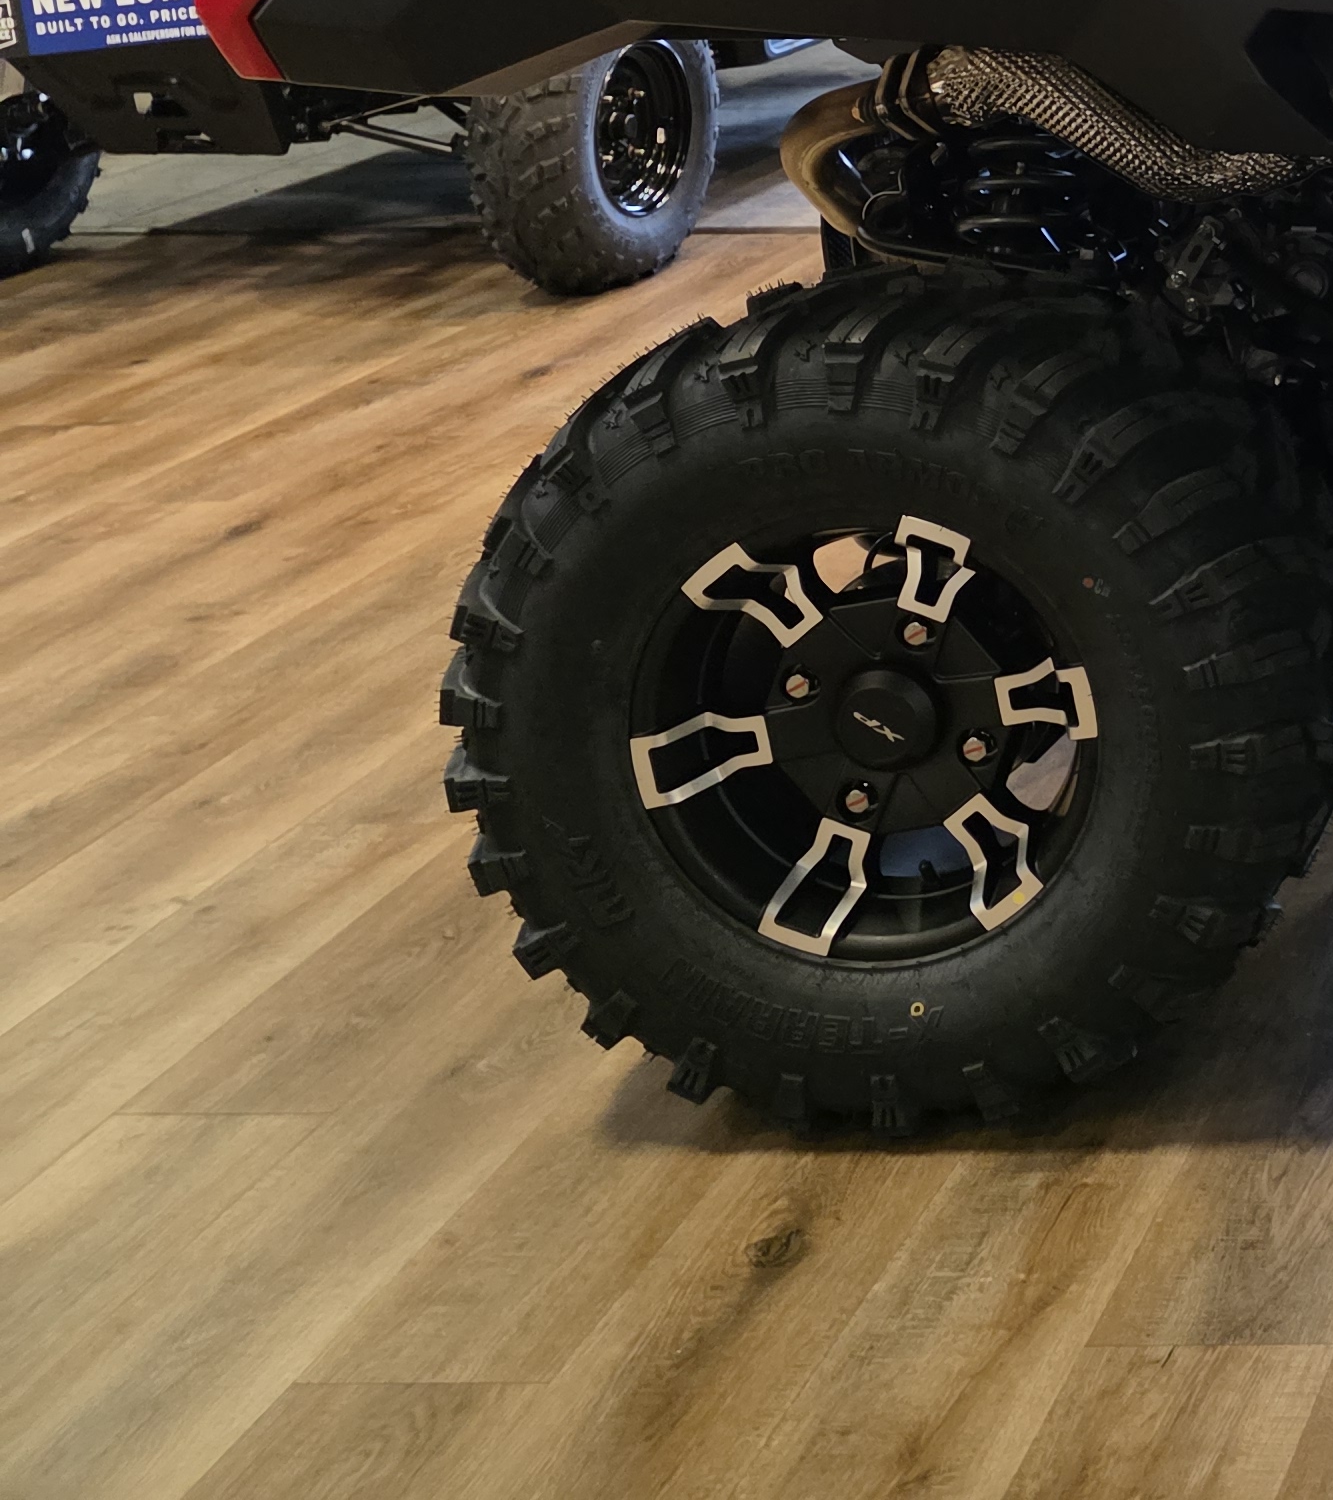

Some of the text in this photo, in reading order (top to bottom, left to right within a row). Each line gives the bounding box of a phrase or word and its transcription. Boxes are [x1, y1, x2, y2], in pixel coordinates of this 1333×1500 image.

[35, 18, 84, 36] BUILT
[90, 14, 111, 29] TO
[150, 5, 200, 24] PRICE
[853, 709, 906, 742] XP
